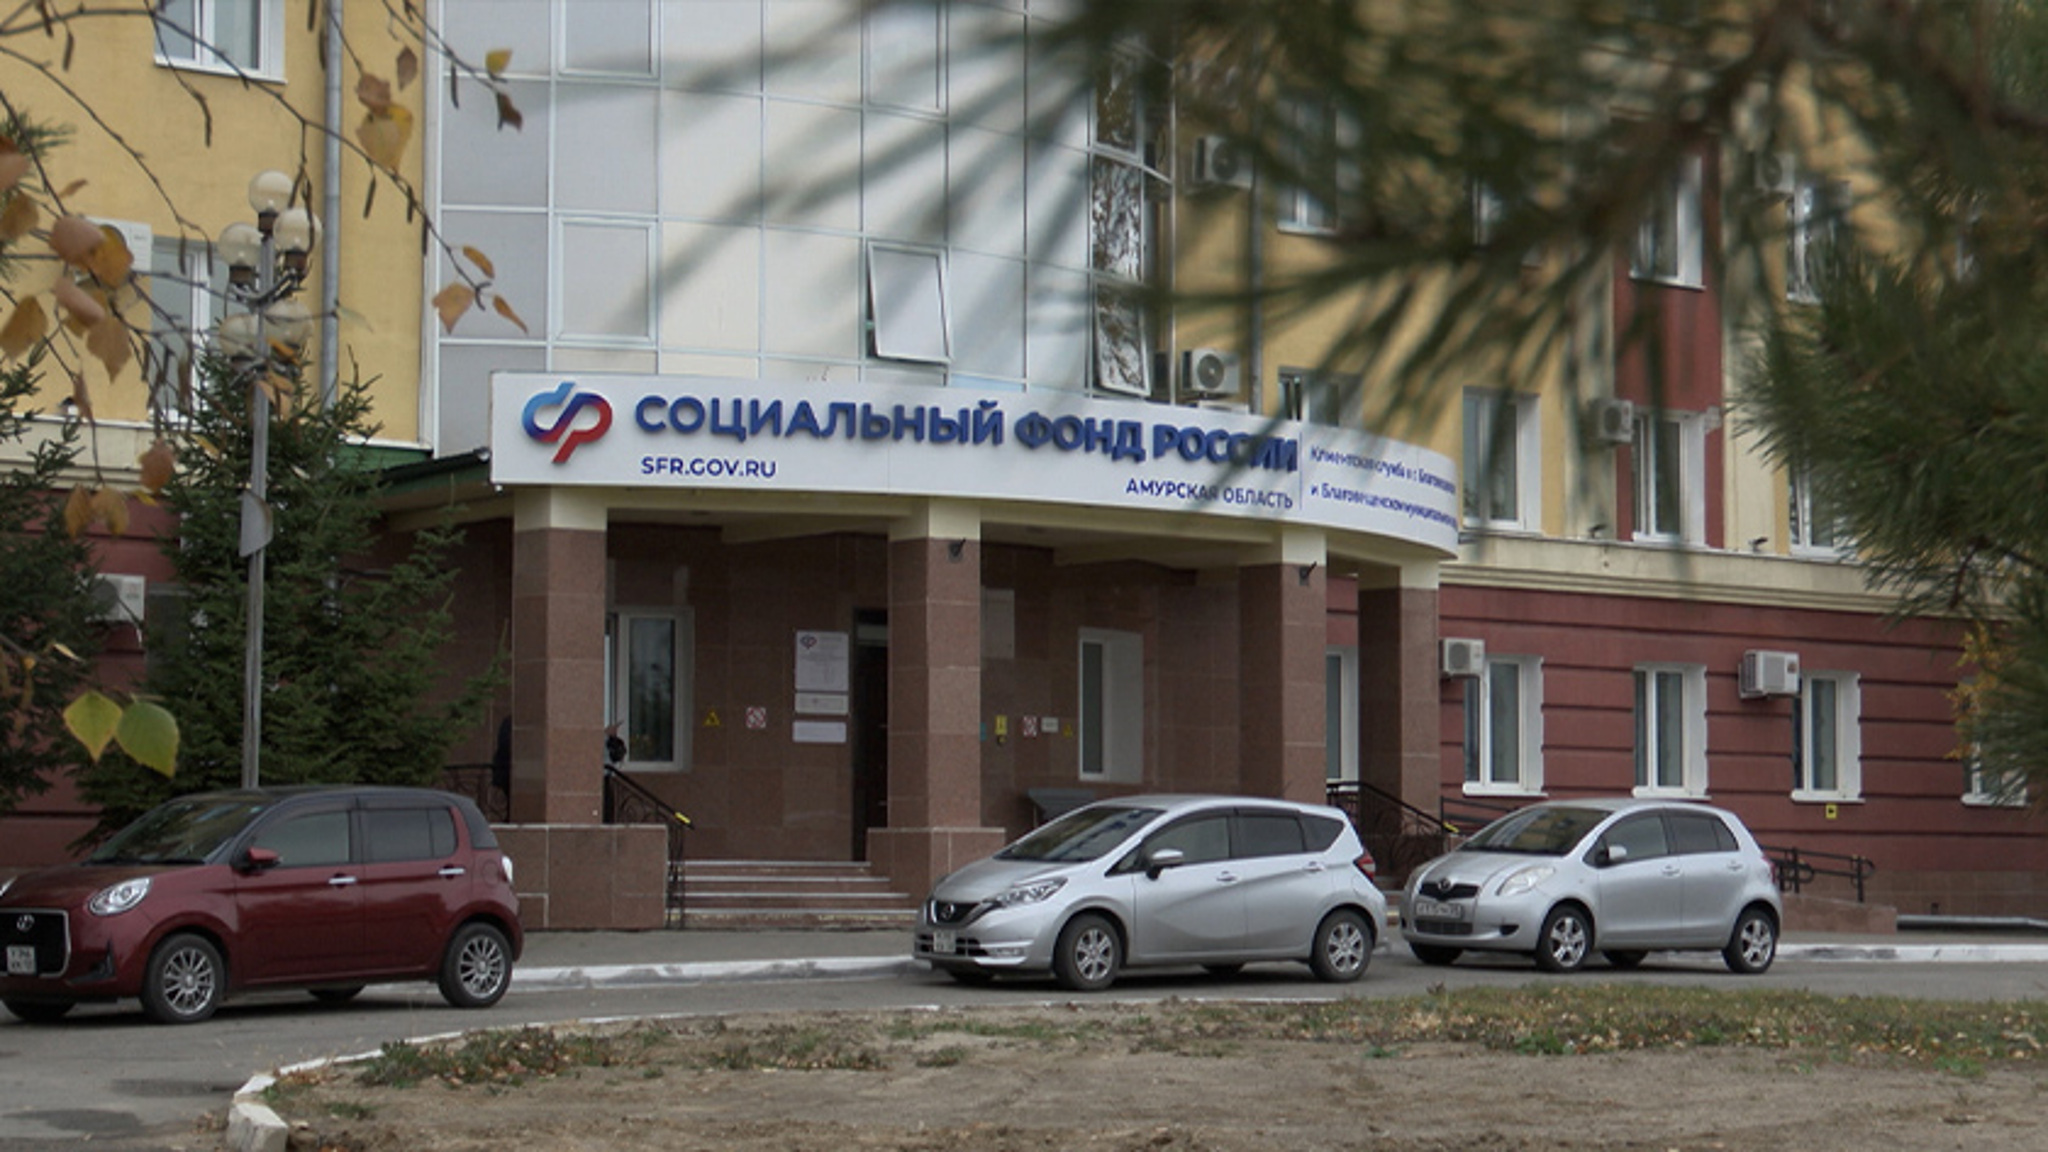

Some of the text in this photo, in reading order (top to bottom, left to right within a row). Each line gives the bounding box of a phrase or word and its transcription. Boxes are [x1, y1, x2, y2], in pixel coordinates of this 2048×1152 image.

[635, 395, 1298, 472] СОЦИАЛЬНЫЙ ФОНД РОССИИ
[641, 456, 776, 478] SFR.GOV.RU
[1126, 477, 1293, 509] АМУРСКАЯ ОБЛАСТЬ
